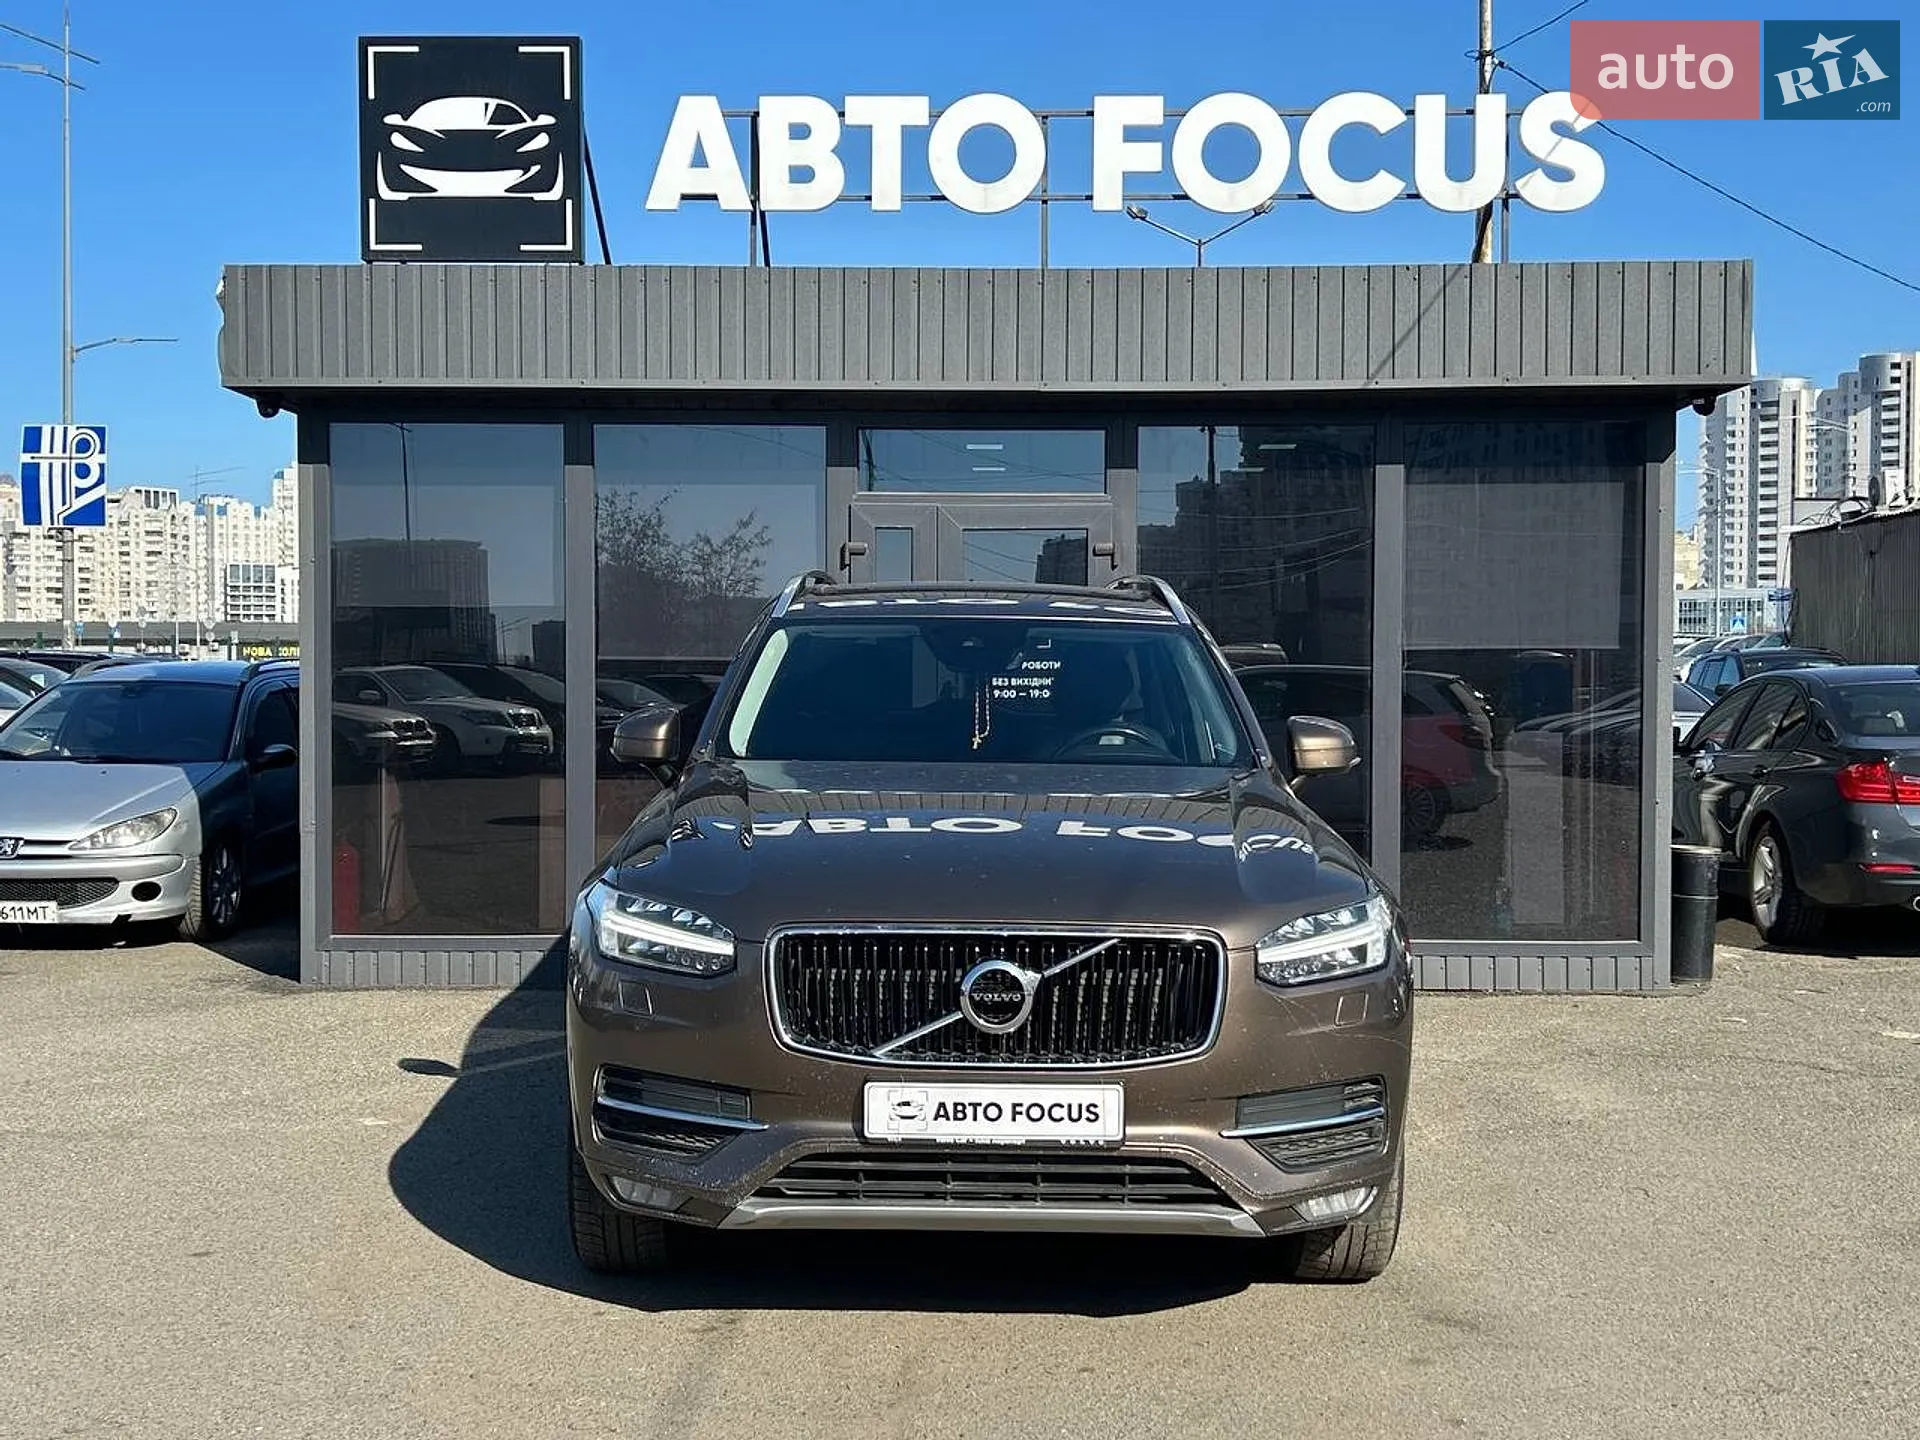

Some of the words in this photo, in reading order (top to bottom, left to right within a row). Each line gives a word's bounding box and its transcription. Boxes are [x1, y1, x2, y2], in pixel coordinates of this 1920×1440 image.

[1093, 91, 1606, 213] FOCUS
[1010, 677, 1054, 687] ВИХІДНИ
[971, 993, 1021, 1002] VOLVO
[1011, 1102, 1100, 1123] FOCUS
